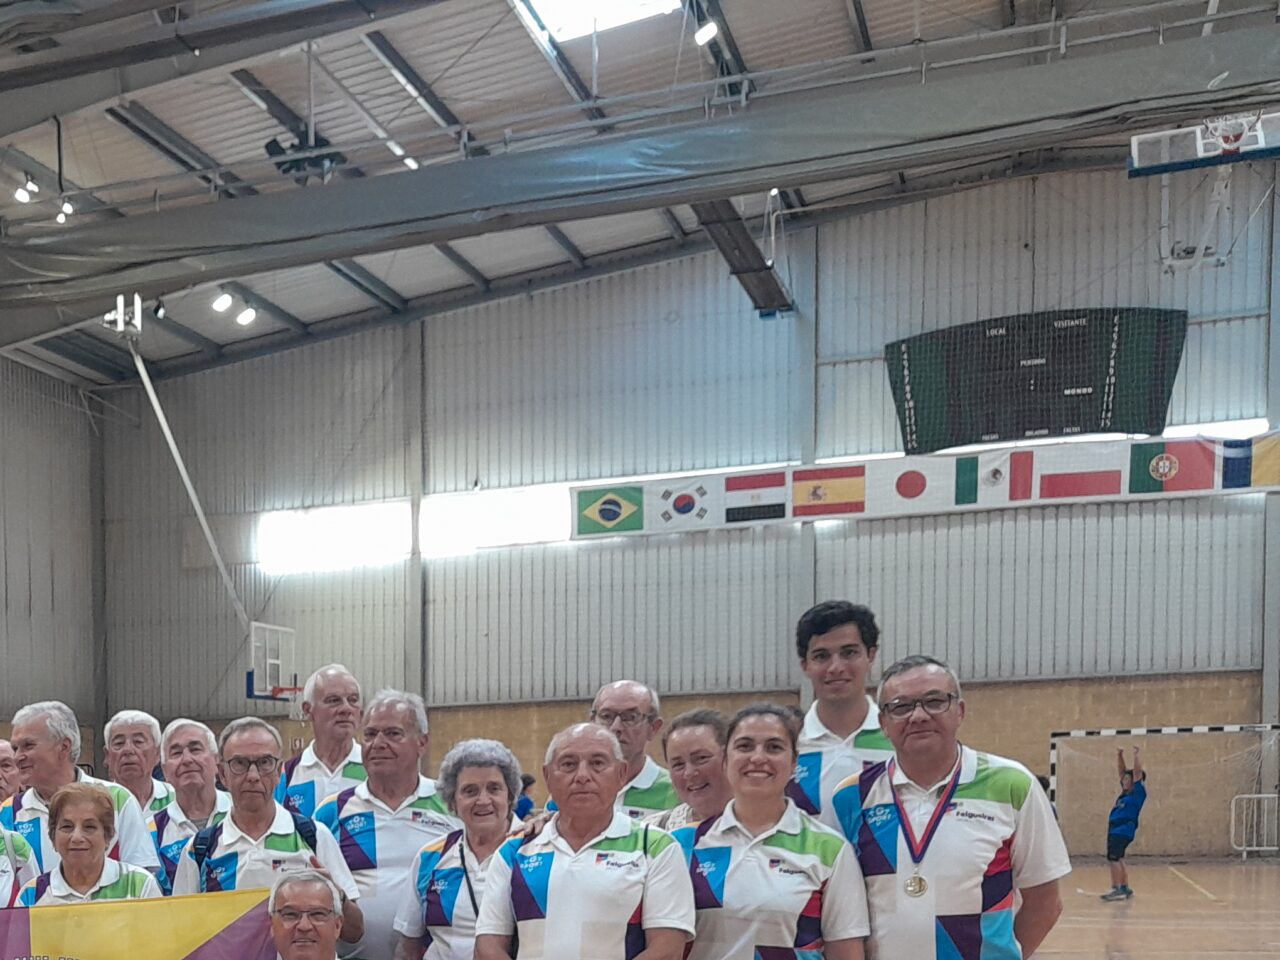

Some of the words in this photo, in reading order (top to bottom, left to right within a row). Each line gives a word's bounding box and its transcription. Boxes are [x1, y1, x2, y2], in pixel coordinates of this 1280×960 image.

[1054, 318, 1088, 329] VISITANTE
[986, 327, 1007, 337] LOCAL
[1064, 387, 1093, 396] MONDO
